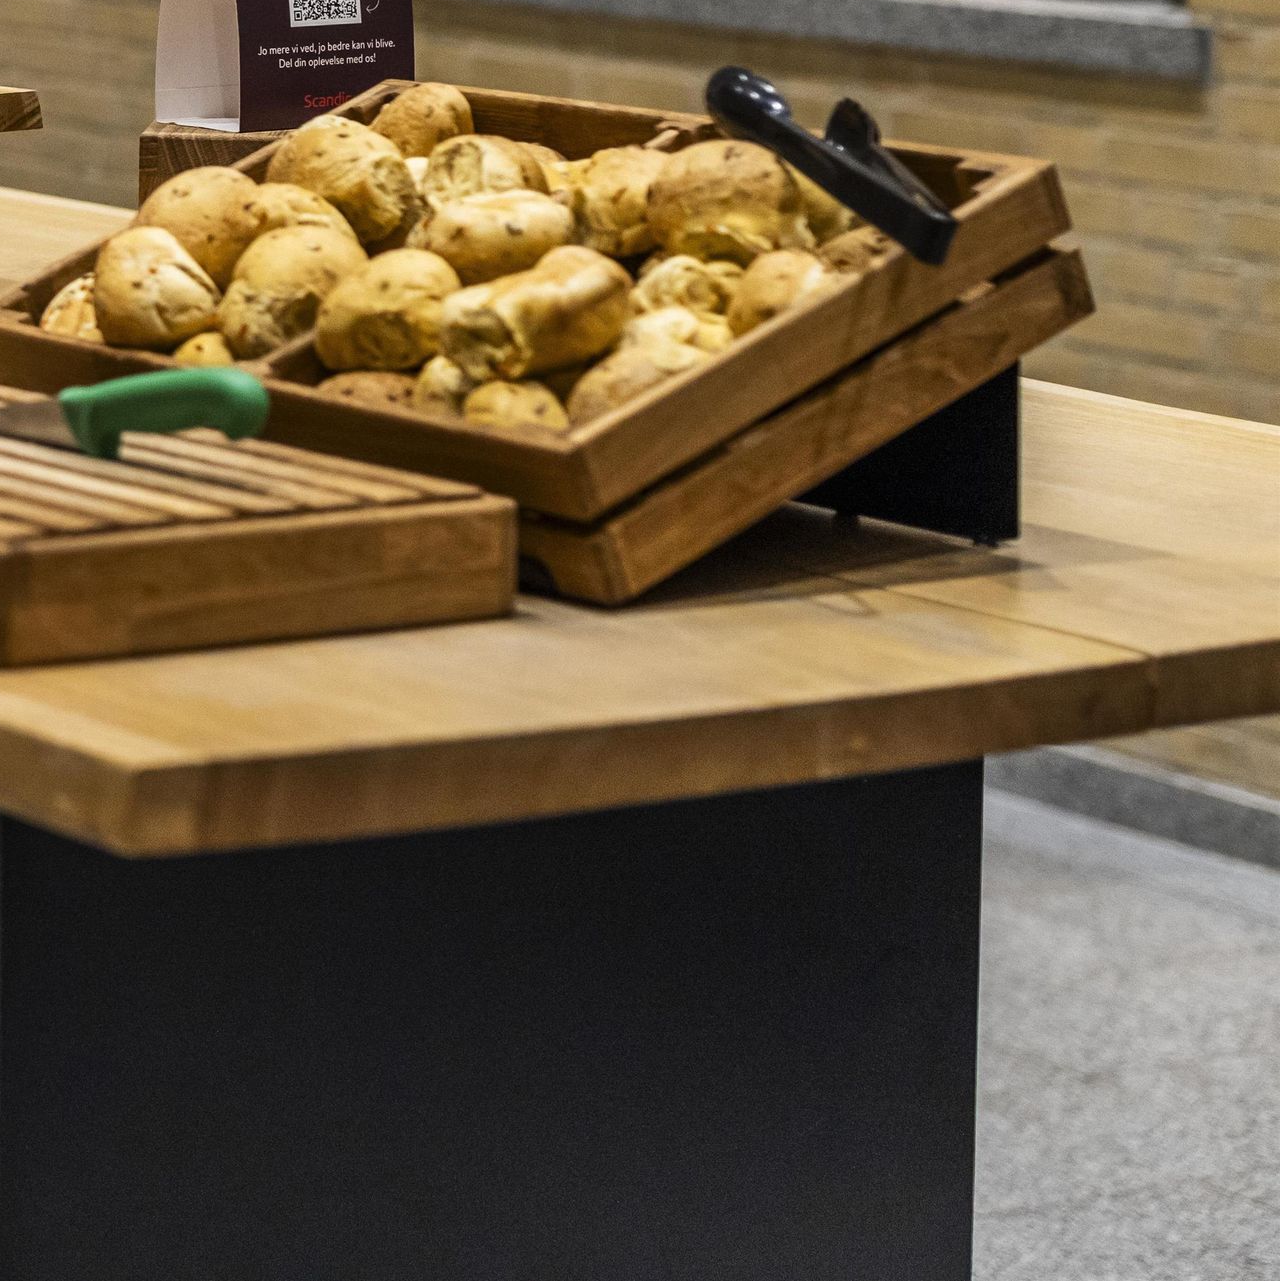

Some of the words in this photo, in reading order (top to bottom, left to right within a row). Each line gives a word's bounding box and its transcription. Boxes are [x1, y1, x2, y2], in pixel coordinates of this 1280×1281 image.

[257, 46, 268, 56] Jo
[269, 46, 290, 55] mere
[291, 44, 299, 54] vi
[300, 43, 317, 54] ved,
[318, 42, 326, 54] jo
[327, 41, 350, 52] bedre
[351, 40, 366, 50] kan
[366, 39, 374, 49] vi
[375, 38, 396, 49] blive.
[278, 58, 293, 69] Del
[294, 57, 307, 67] din
[308, 55, 345, 69] oplevelse
[346, 53, 364, 64] med
[364, 52, 377, 63] os!
